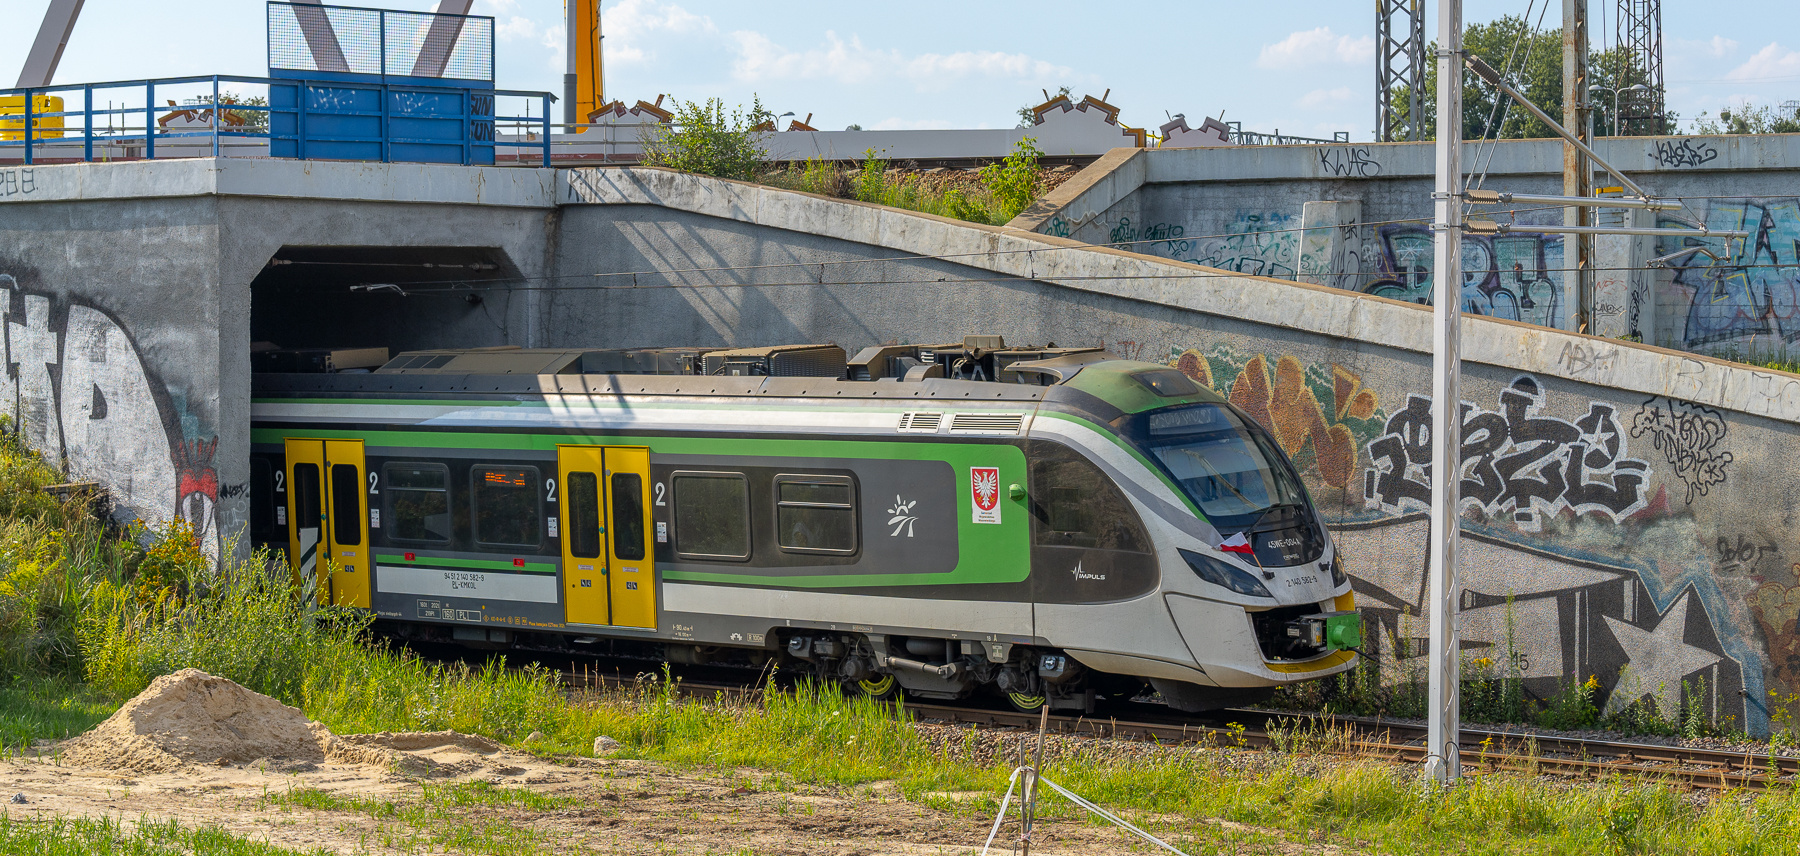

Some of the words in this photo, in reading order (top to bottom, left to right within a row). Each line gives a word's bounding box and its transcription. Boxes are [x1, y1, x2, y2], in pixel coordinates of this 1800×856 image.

[275, 470, 285, 492] 2
[369, 472, 379, 495] 2
[546, 478, 557, 502] 2
[655, 482, 666, 507] 2
[1078, 573, 1106, 581] IMPULS
